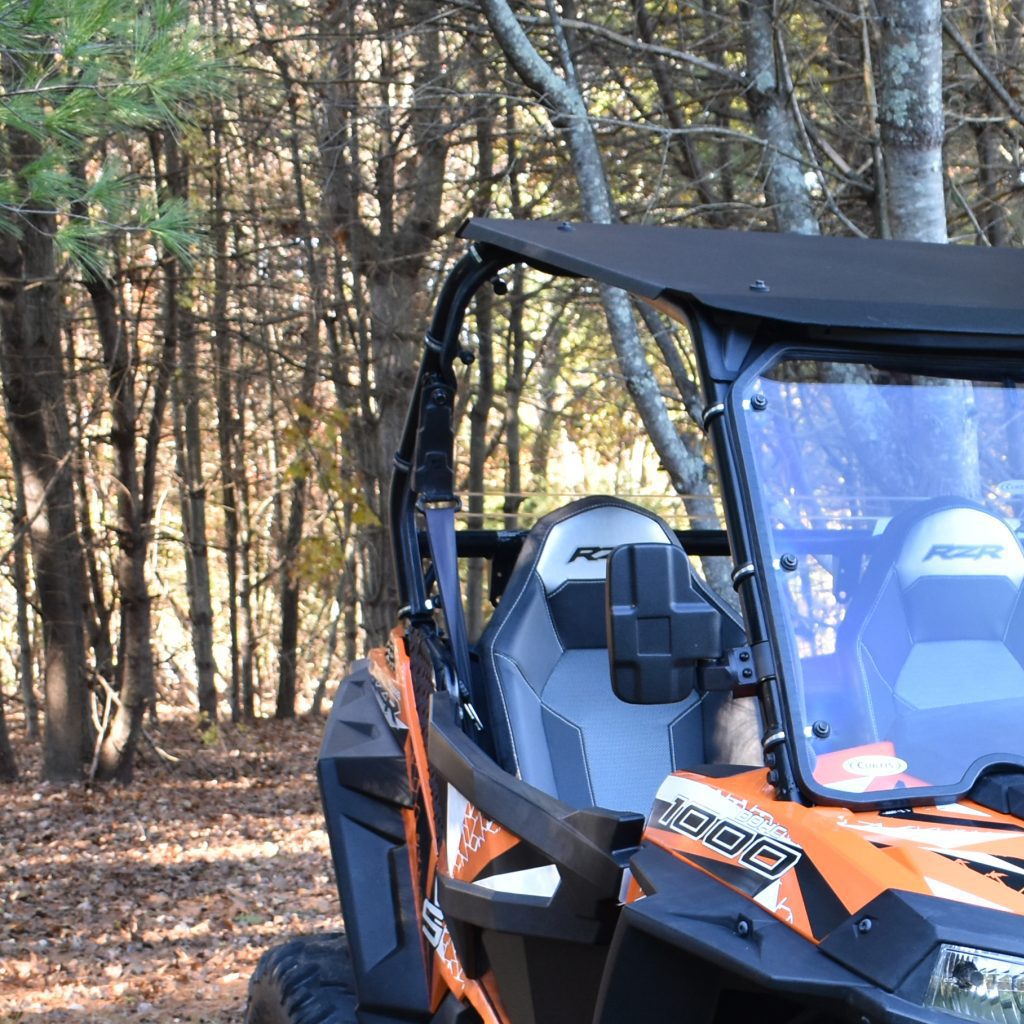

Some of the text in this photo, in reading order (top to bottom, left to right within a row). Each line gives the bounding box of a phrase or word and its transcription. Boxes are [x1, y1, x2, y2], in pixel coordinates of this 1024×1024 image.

[567, 546, 614, 563] RZ
[922, 543, 1004, 562] RZR
[658, 795, 802, 880] 1000
